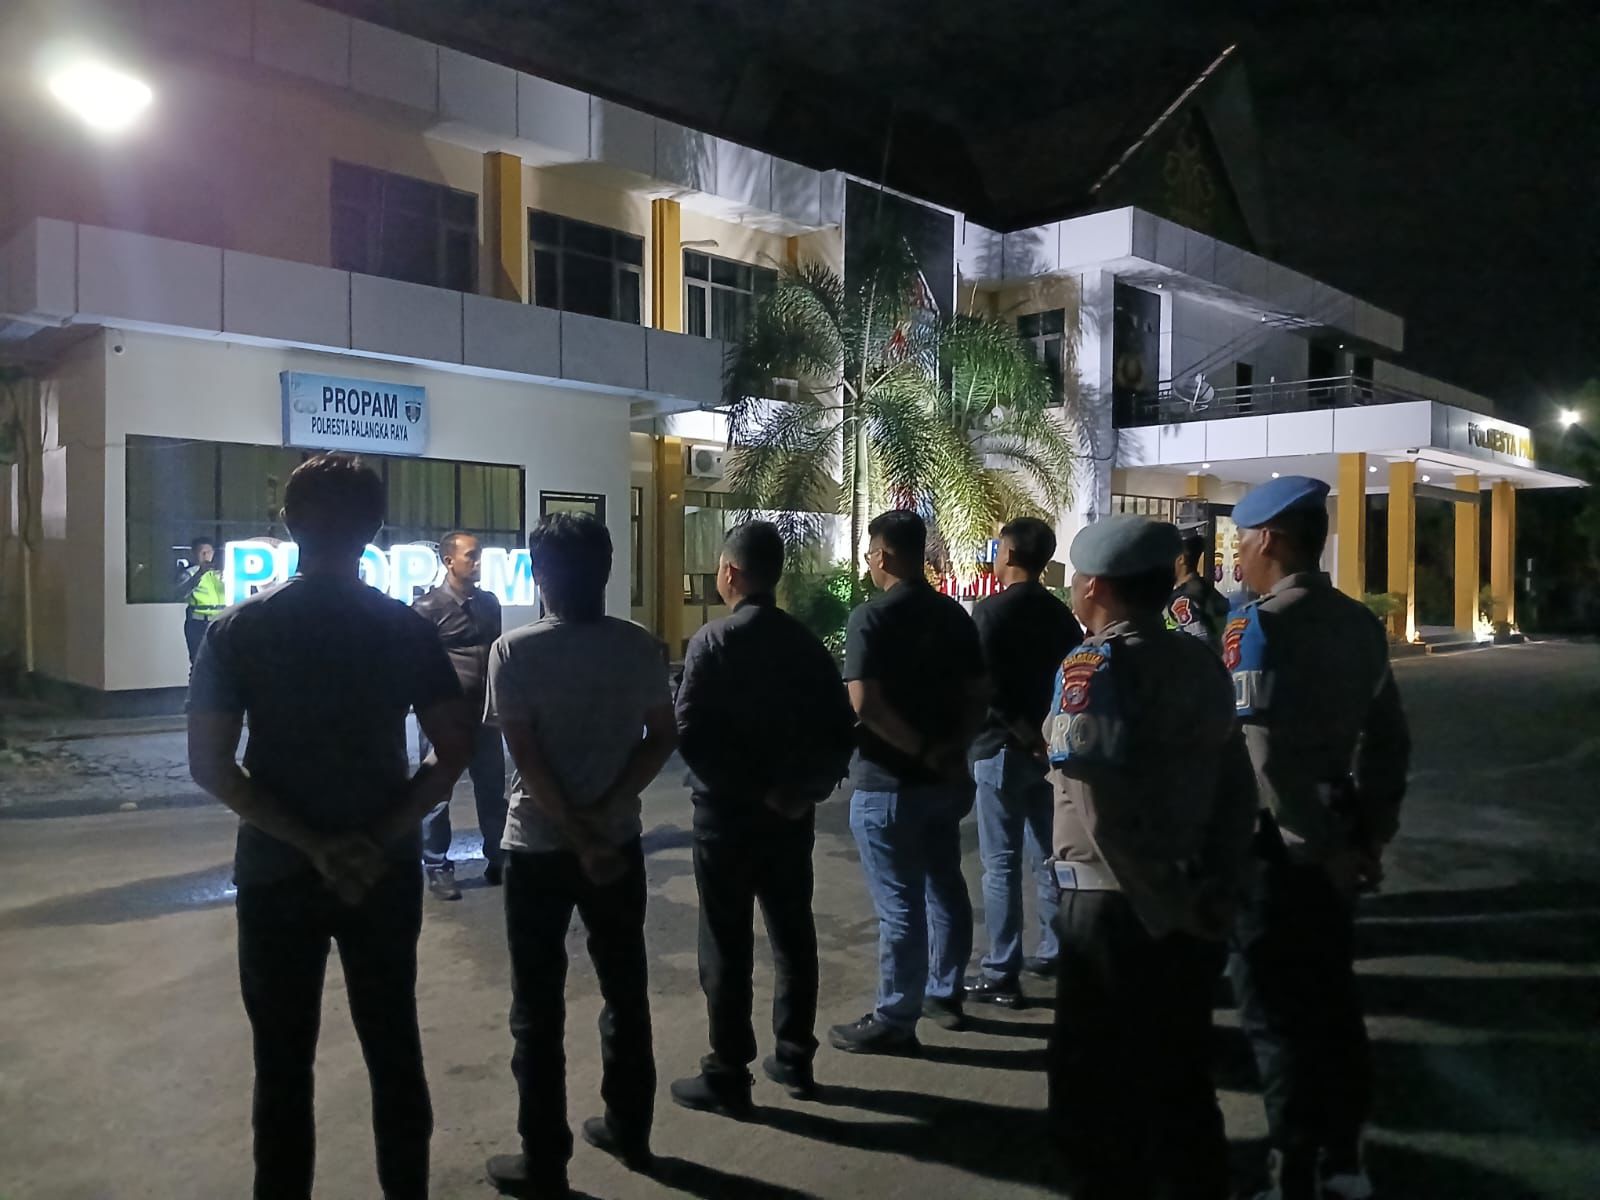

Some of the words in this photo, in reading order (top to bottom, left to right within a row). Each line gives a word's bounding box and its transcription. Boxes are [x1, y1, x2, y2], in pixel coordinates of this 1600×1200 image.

[323, 386, 398, 419] PROPAM
[312, 416, 350, 435] POLRESTA
[351, 420, 388, 439] PALANGKA
[390, 423, 408, 441] RAYA
[224, 541, 534, 605] POPM
